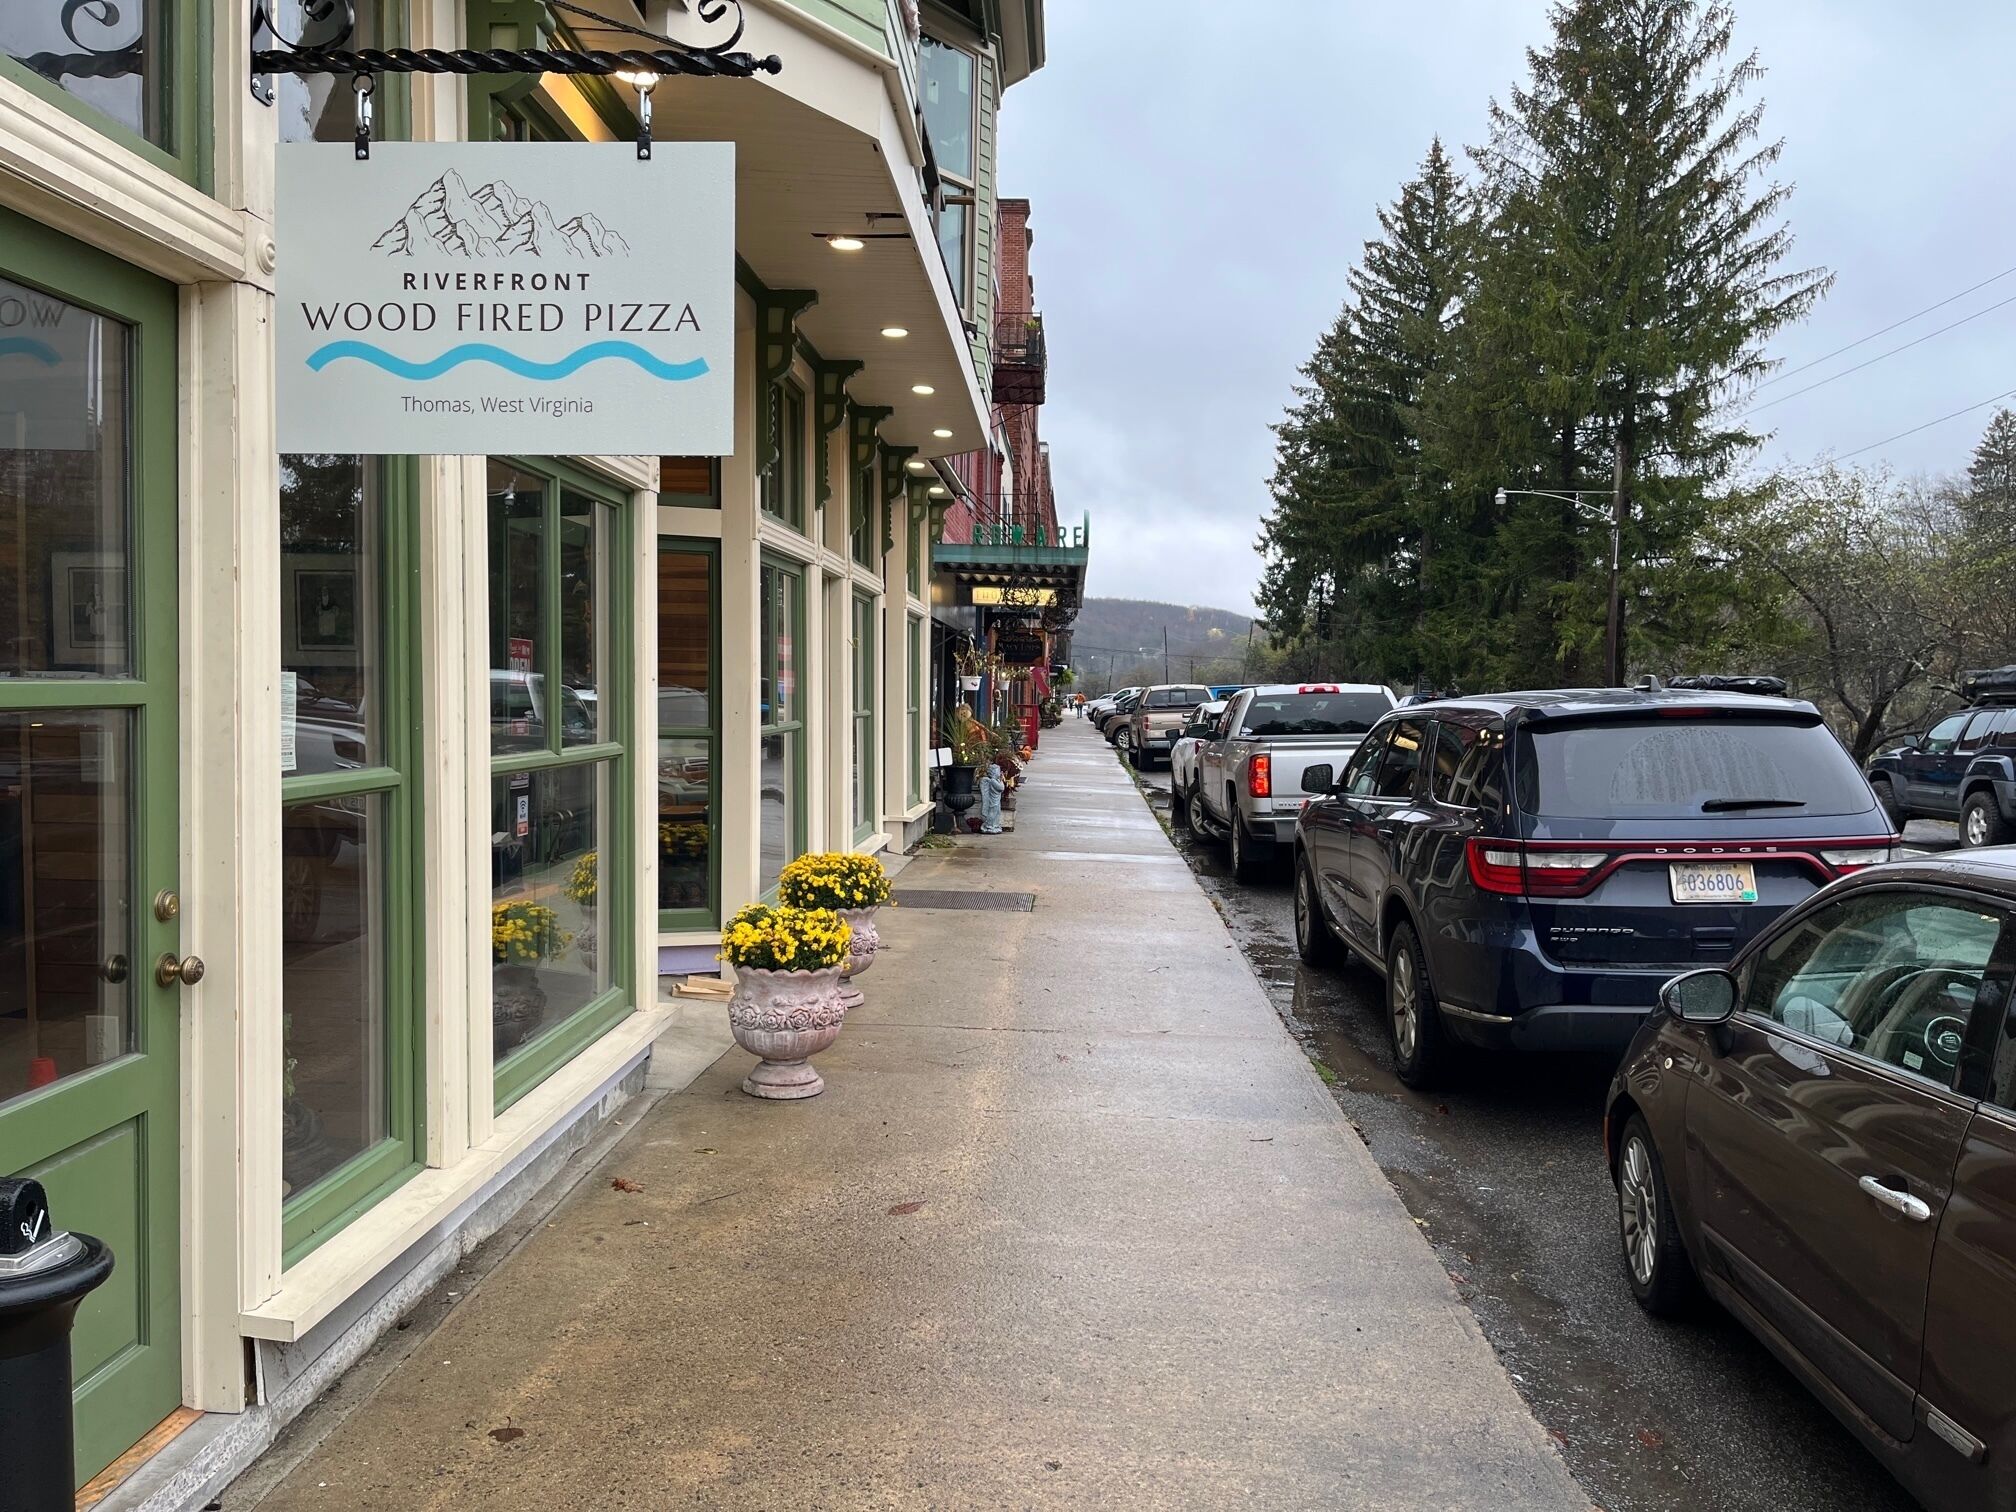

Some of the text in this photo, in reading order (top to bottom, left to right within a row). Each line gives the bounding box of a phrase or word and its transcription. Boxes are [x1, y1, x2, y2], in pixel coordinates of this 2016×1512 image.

[403, 272, 591, 291] RIVERFRONT
[300, 302, 701, 332] WOOD FIRED PIZZA
[401, 396, 593, 418] Thomas, West Virginia
[1654, 846, 1778, 854] DODGE
[1687, 873, 1745, 891] 036806
